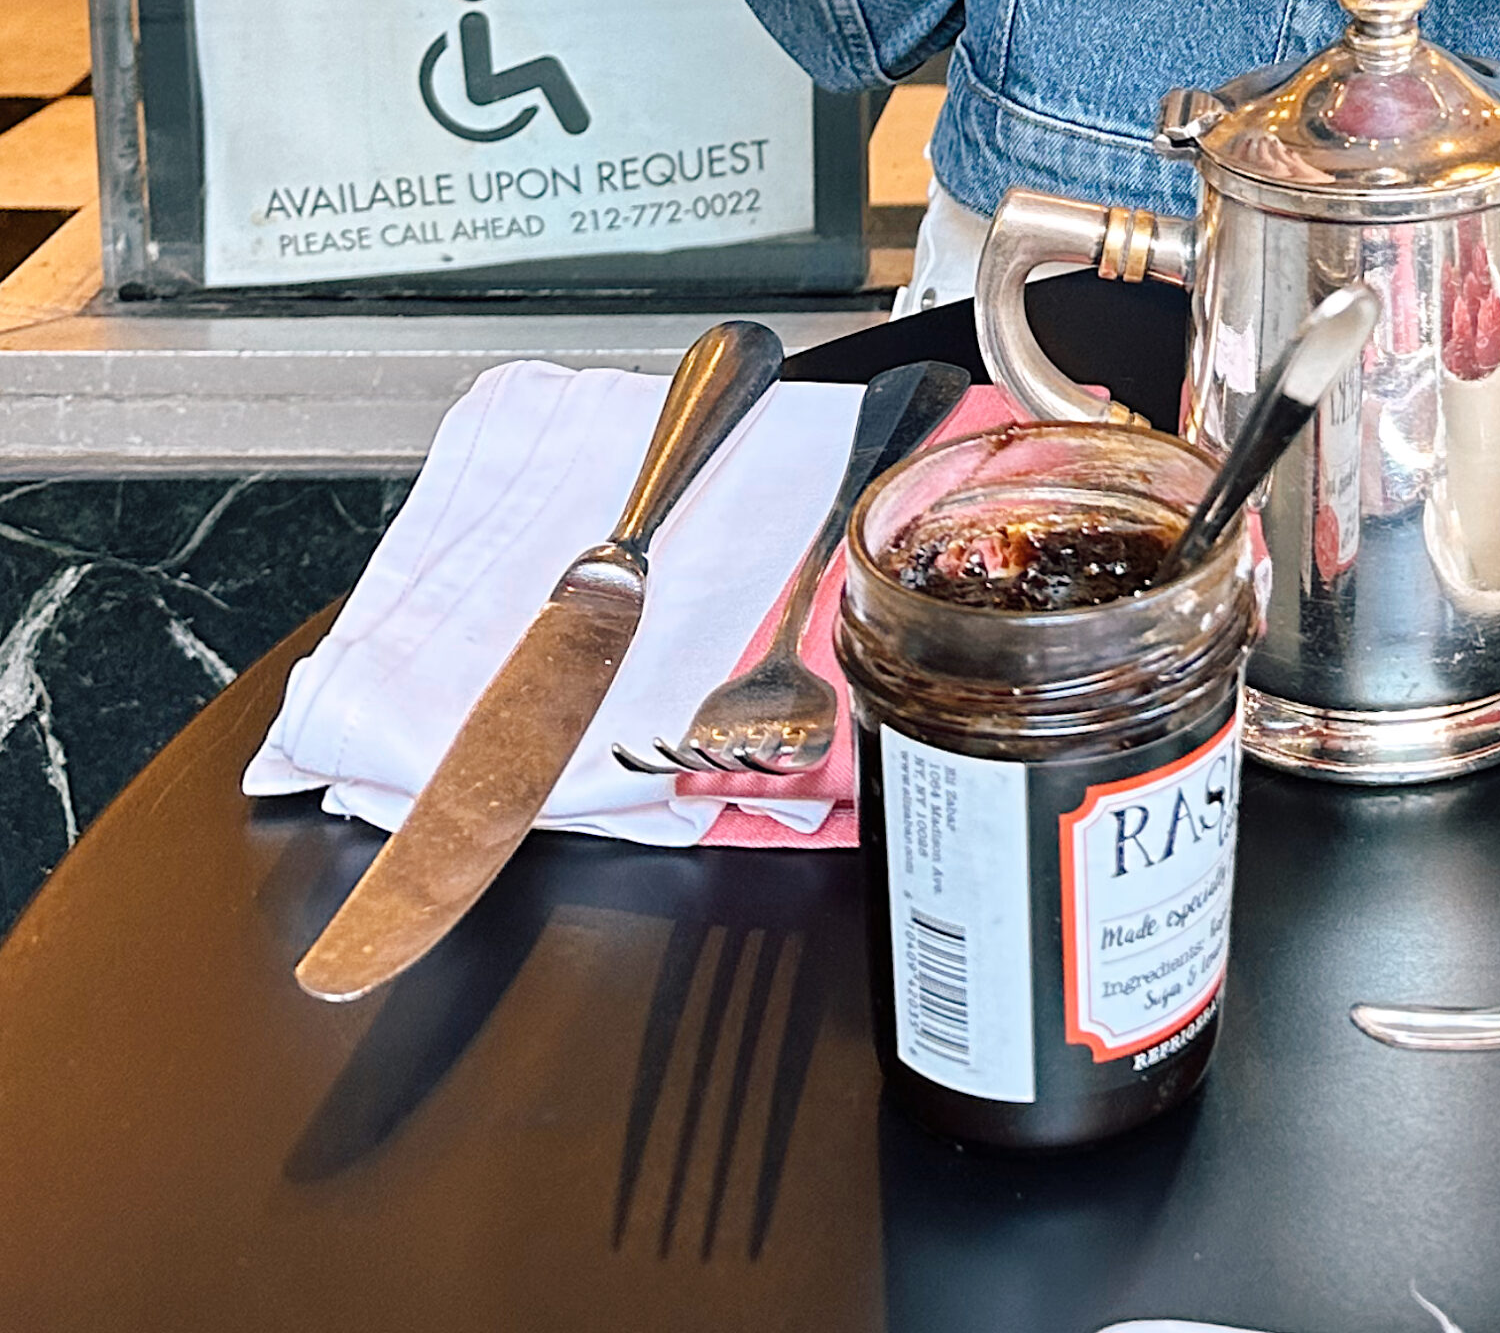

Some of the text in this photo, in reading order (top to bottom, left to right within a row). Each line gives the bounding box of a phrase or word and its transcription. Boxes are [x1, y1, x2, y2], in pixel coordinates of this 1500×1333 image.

[264, 140, 770, 220] AVAILABLE UPON REQUEST
[279, 189, 762, 257] PLEASE CALL AHEAD 212-772-0022
[914, 786, 927, 809] NY
[943, 788, 959, 833] Zabar
[930, 803, 944, 863] Madison
[1101, 914, 1160, 951] Made
[1132, 1000, 1218, 1072] REFRIGERA
